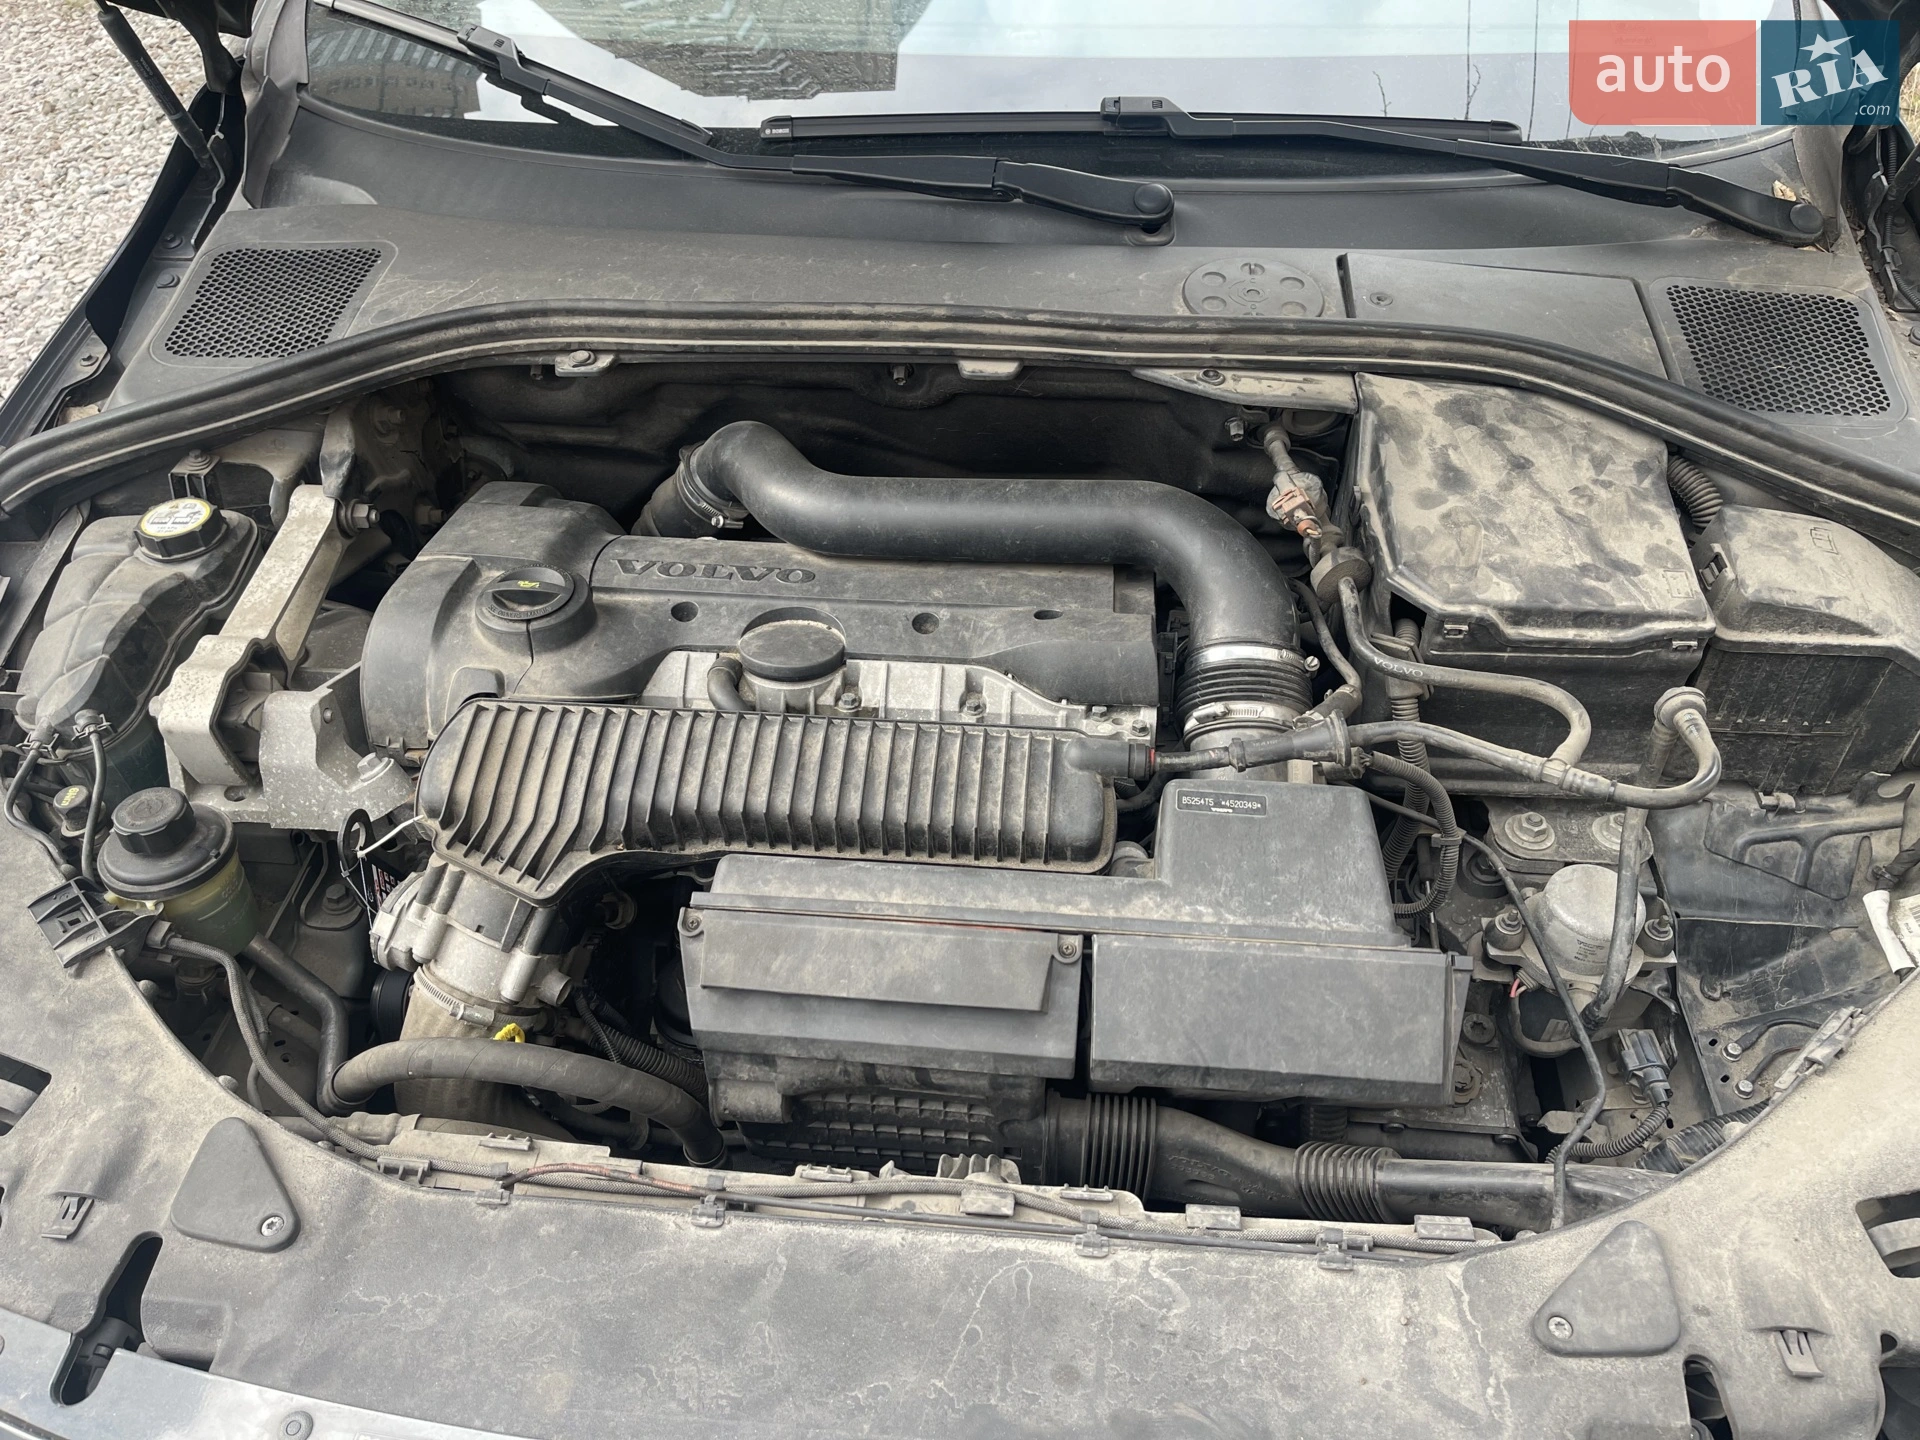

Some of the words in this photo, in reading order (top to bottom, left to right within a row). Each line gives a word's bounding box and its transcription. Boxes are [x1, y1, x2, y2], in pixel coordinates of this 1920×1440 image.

[611, 558, 816, 584] VOLVO
[1373, 656, 1424, 677] VOLVO
[1182, 796, 1215, 806] B5254T5
